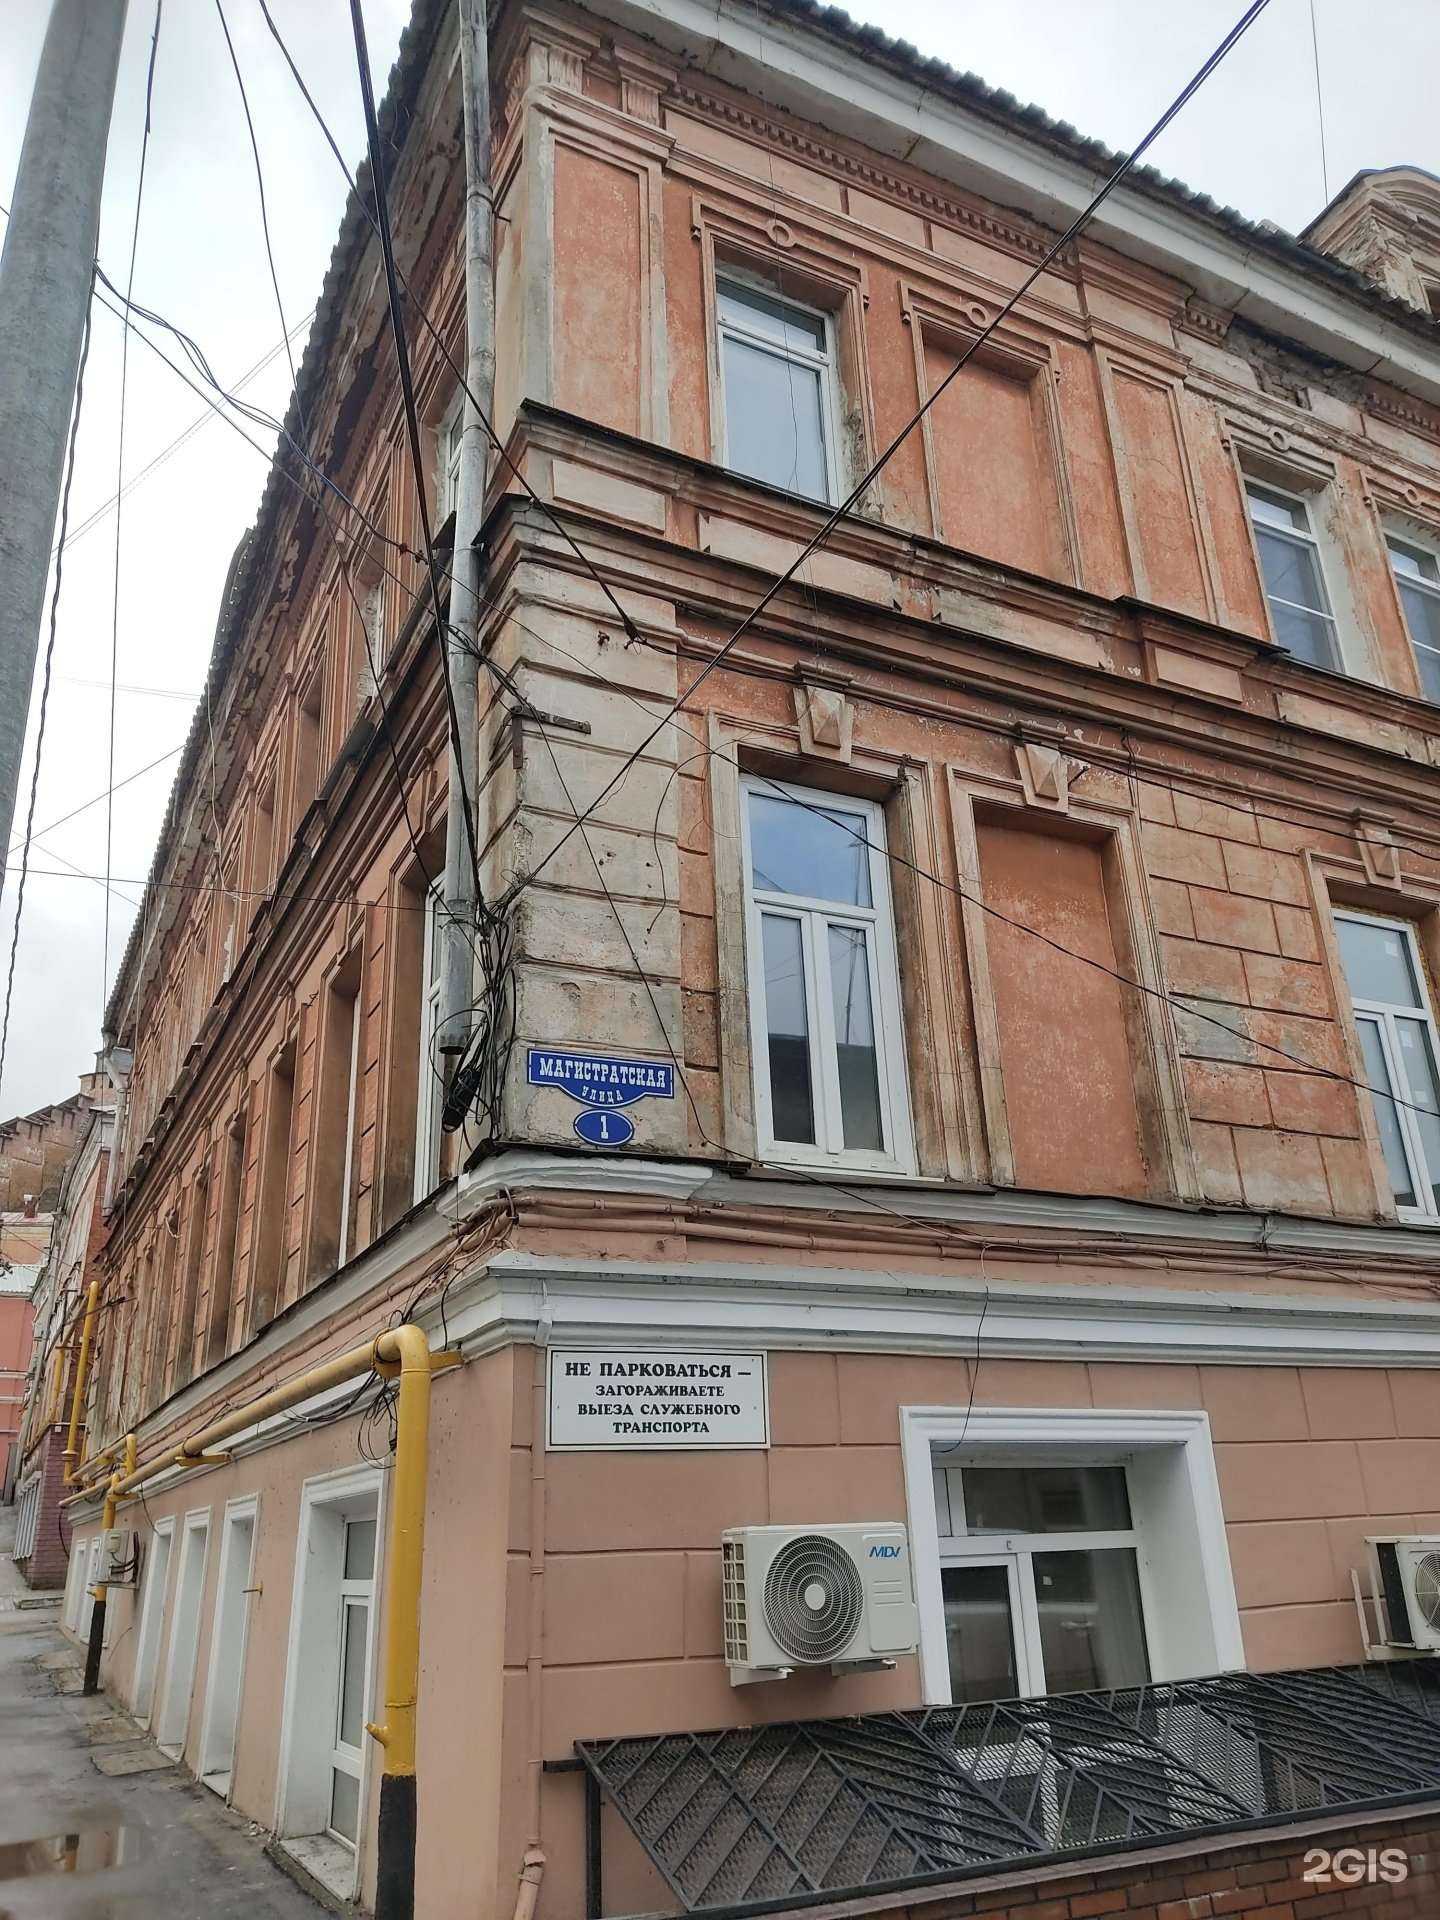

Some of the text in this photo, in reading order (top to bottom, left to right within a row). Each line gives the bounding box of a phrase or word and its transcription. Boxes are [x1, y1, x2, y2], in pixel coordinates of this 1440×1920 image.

[540, 1058, 666, 1088] МАГИСТРАТСКАЯ
[581, 1086, 624, 1104] УЛИЦА
[600, 1115, 609, 1140] 1
[565, 1362, 592, 1376] НЕ
[600, 1362, 732, 1378] ПАРКОВАТЬСЯ
[595, 1384, 725, 1397] ЗАГОРАЖИВАЕТЕ
[578, 1403, 741, 1416] ВЫЕЗД СЛУЖЕБНОГО
[613, 1421, 710, 1434] ТРАНСПОРТА
[869, 1546, 901, 1558] MDV
